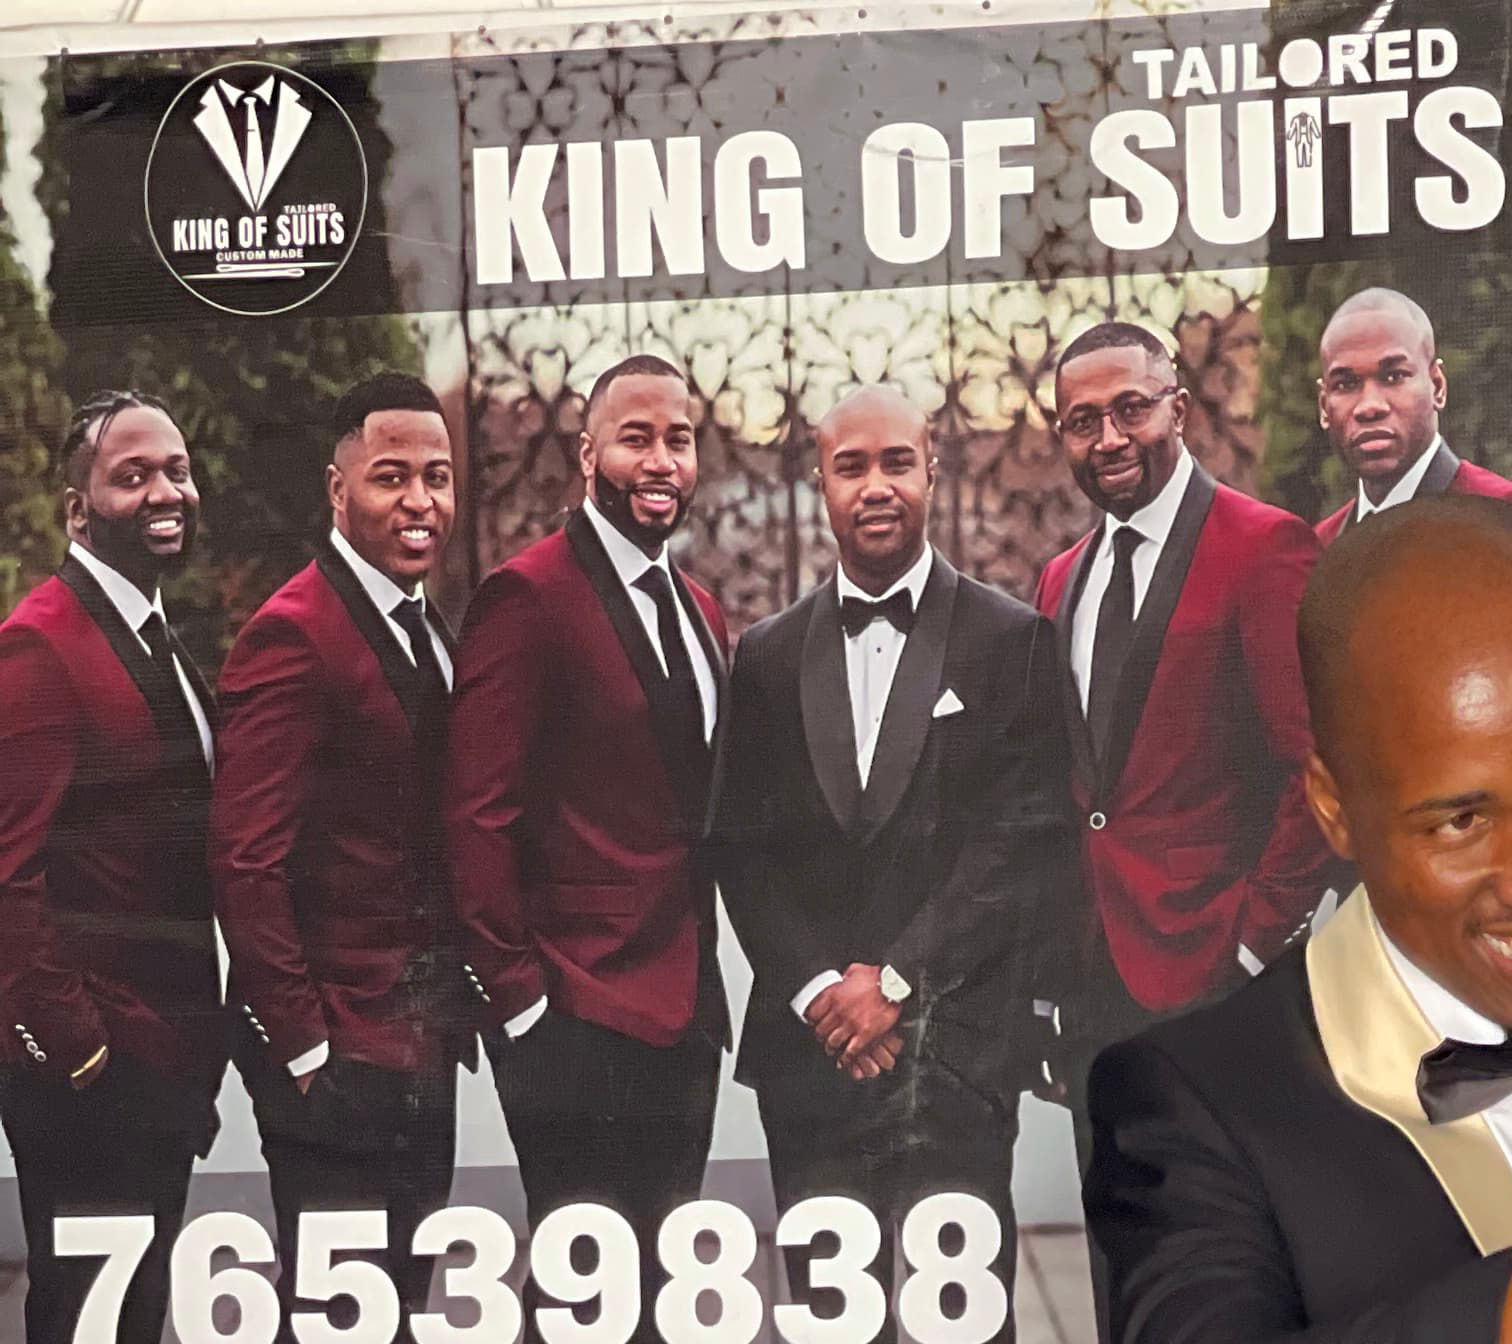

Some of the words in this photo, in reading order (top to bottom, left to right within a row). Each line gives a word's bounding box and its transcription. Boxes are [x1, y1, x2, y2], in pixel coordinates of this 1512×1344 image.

[1133, 28, 1458, 100] TAILORED
[472, 128, 806, 285] KING
[860, 116, 1036, 265] OF
[1088, 86, 1506, 251] SUITS
[283, 203, 337, 214] TAILORED
[173, 218, 230, 252] KING
[238, 215, 268, 248] OF
[276, 212, 345, 246] SUITS
[216, 250, 266, 262] CUSTOM
[269, 248, 304, 260] MADE
